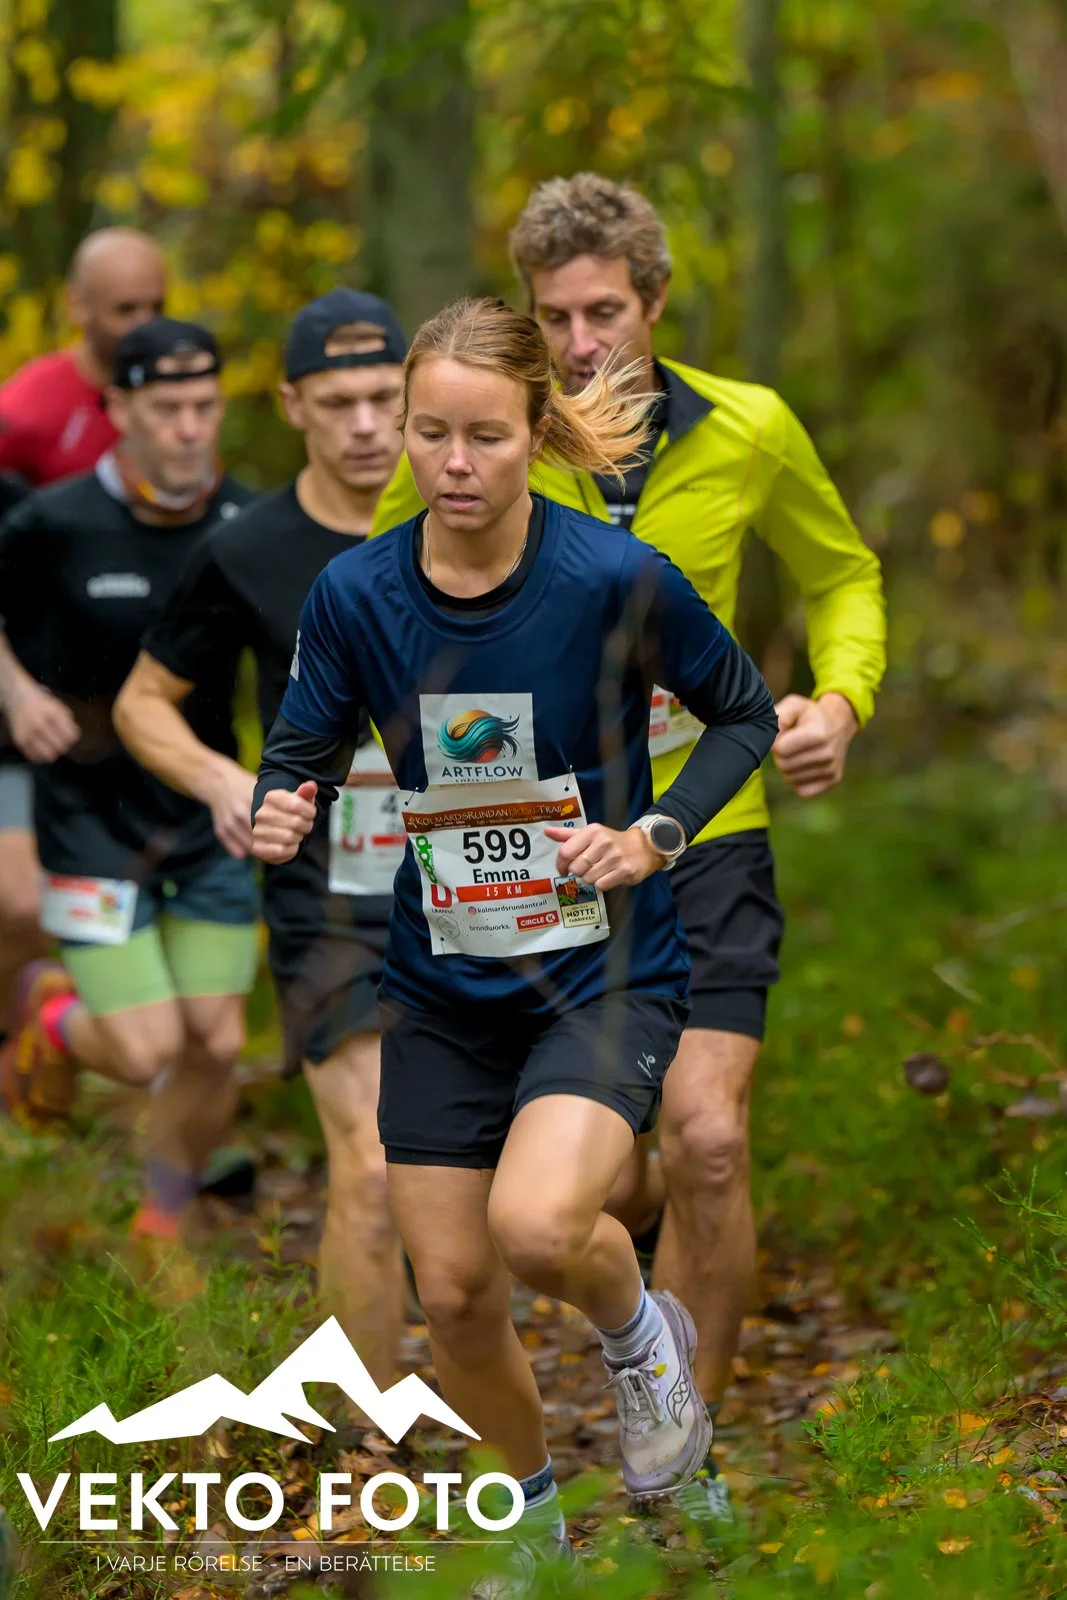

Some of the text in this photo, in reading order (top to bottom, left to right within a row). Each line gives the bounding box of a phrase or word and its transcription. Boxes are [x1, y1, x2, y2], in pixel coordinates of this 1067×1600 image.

[441, 766, 523, 778] ARTFLOW
[462, 827, 532, 865] 599
[473, 868, 531, 884] Emma
[486, 886, 523, 897] 15 KM
[477, 899, 548, 914] kolmardsrundantrail
[566, 907, 596, 919] NØTTE
[520, 917, 545, 927] CIRCLE
